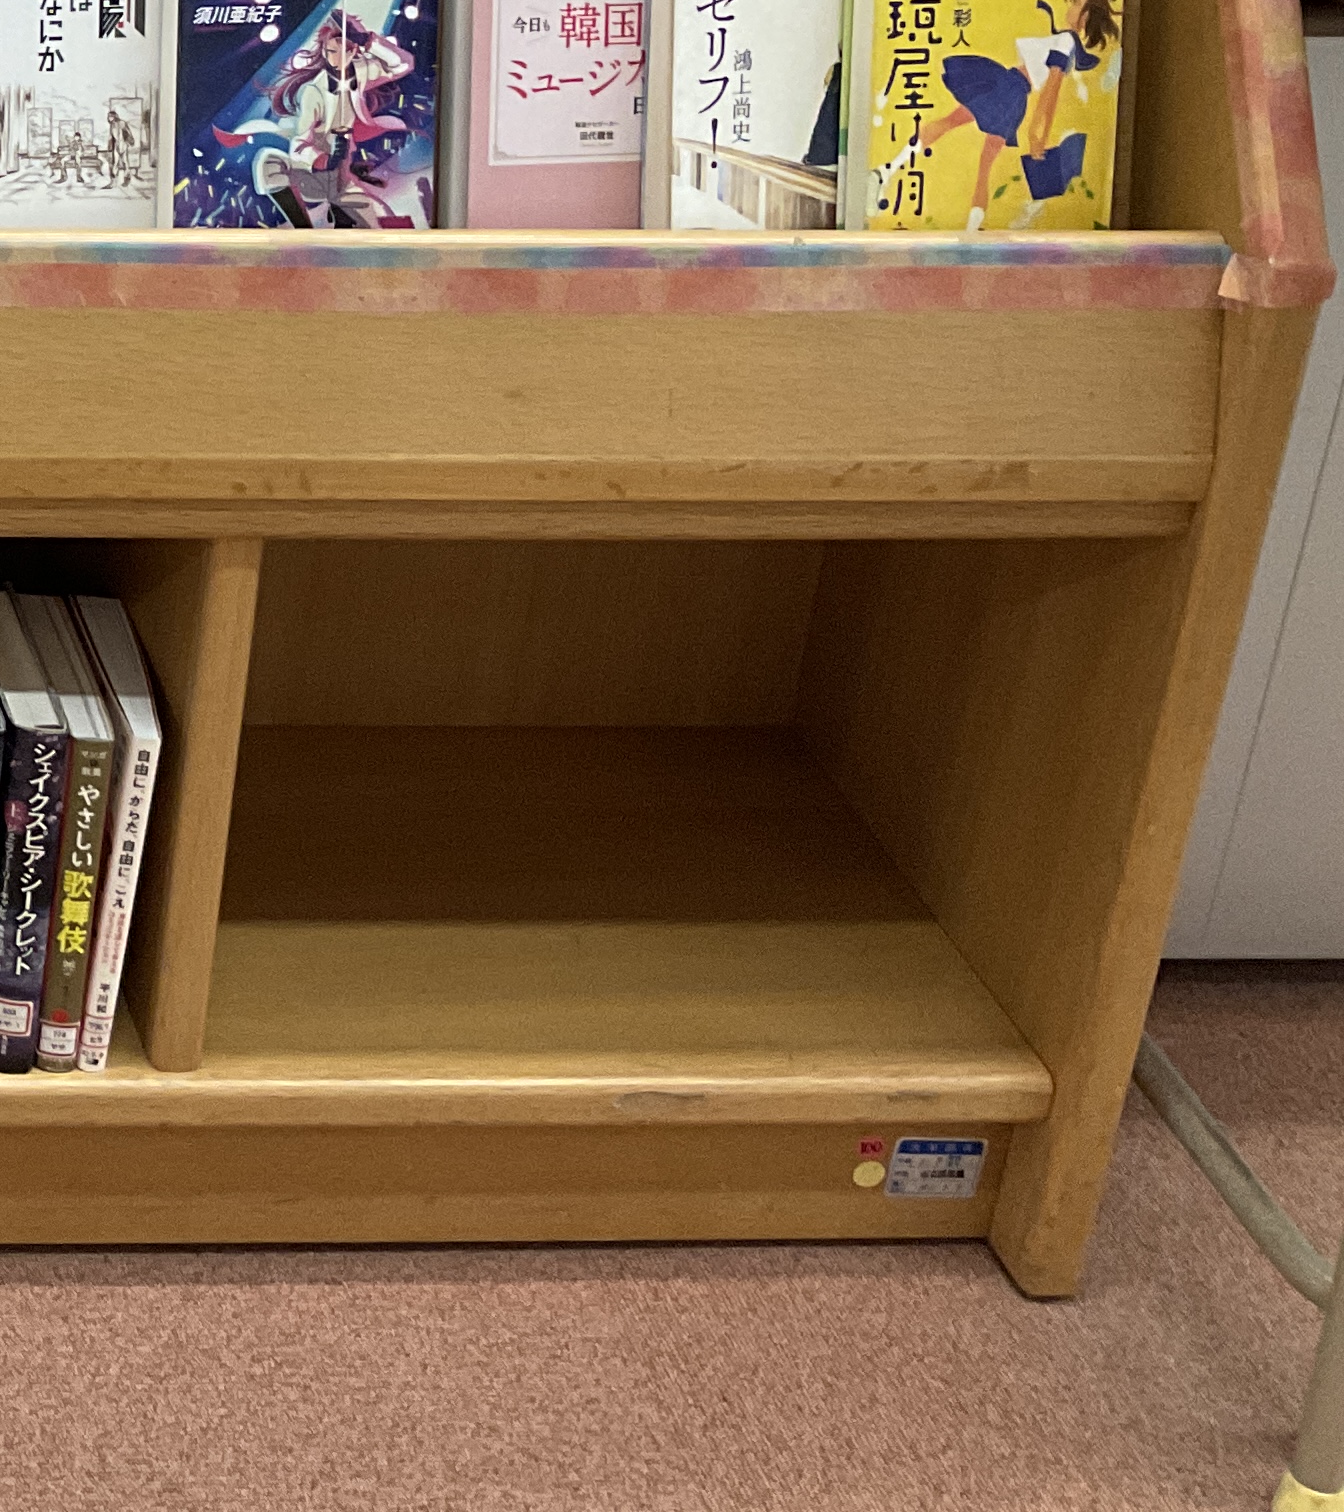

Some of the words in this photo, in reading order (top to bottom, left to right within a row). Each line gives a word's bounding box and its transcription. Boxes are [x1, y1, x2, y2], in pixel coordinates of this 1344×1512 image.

[192, 4, 283, 26] 須川亜紀子
[558, 1, 644, 48] 韓国
[56, 785, 101, 955] やさしい歌舞伎
